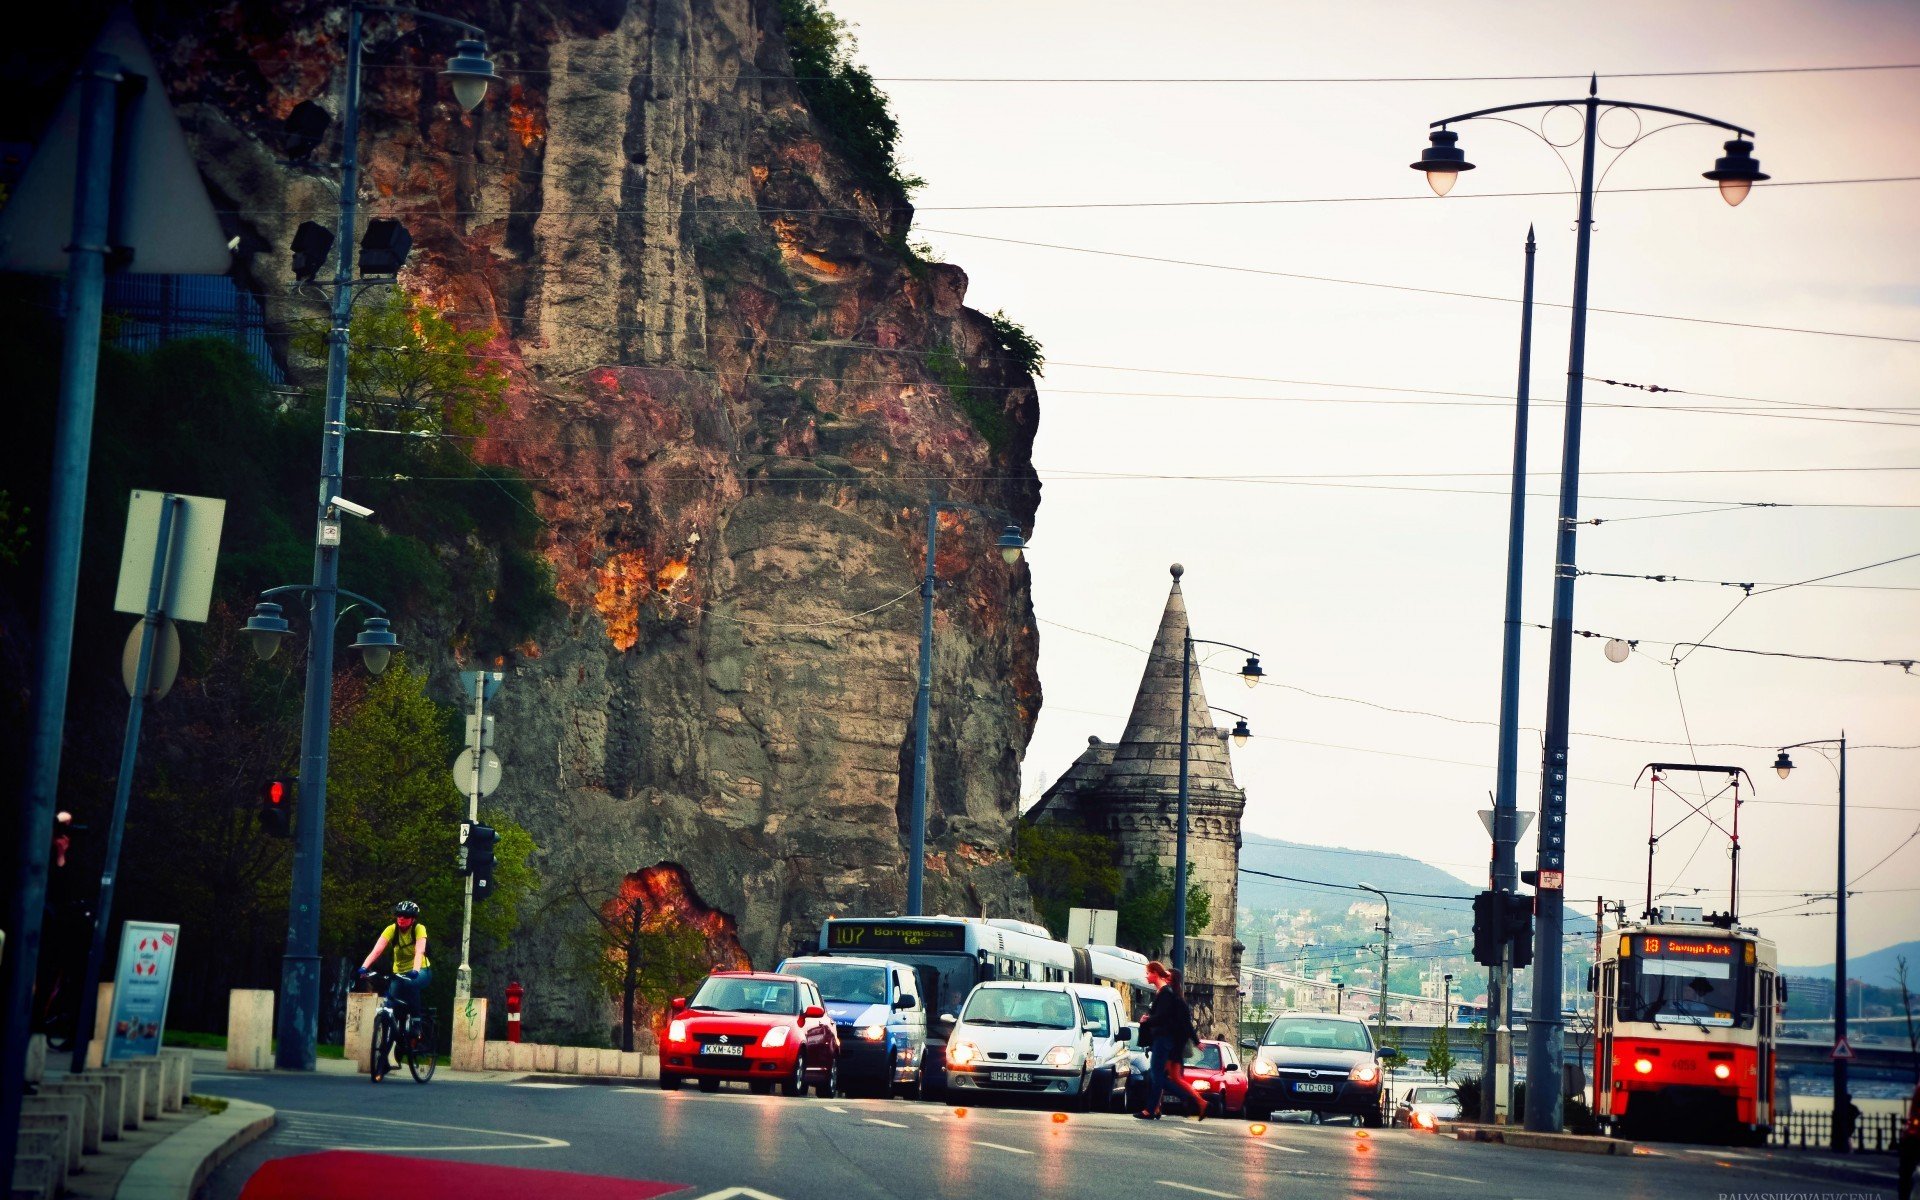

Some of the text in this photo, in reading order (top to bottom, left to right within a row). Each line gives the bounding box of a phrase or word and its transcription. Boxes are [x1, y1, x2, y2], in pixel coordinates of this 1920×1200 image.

[836, 927, 954, 944] 107 Bornemissza
[904, 937, 924, 945] tér
[1706, 944, 1730, 955] Park
[706, 1044, 742, 1055] KXM-456
